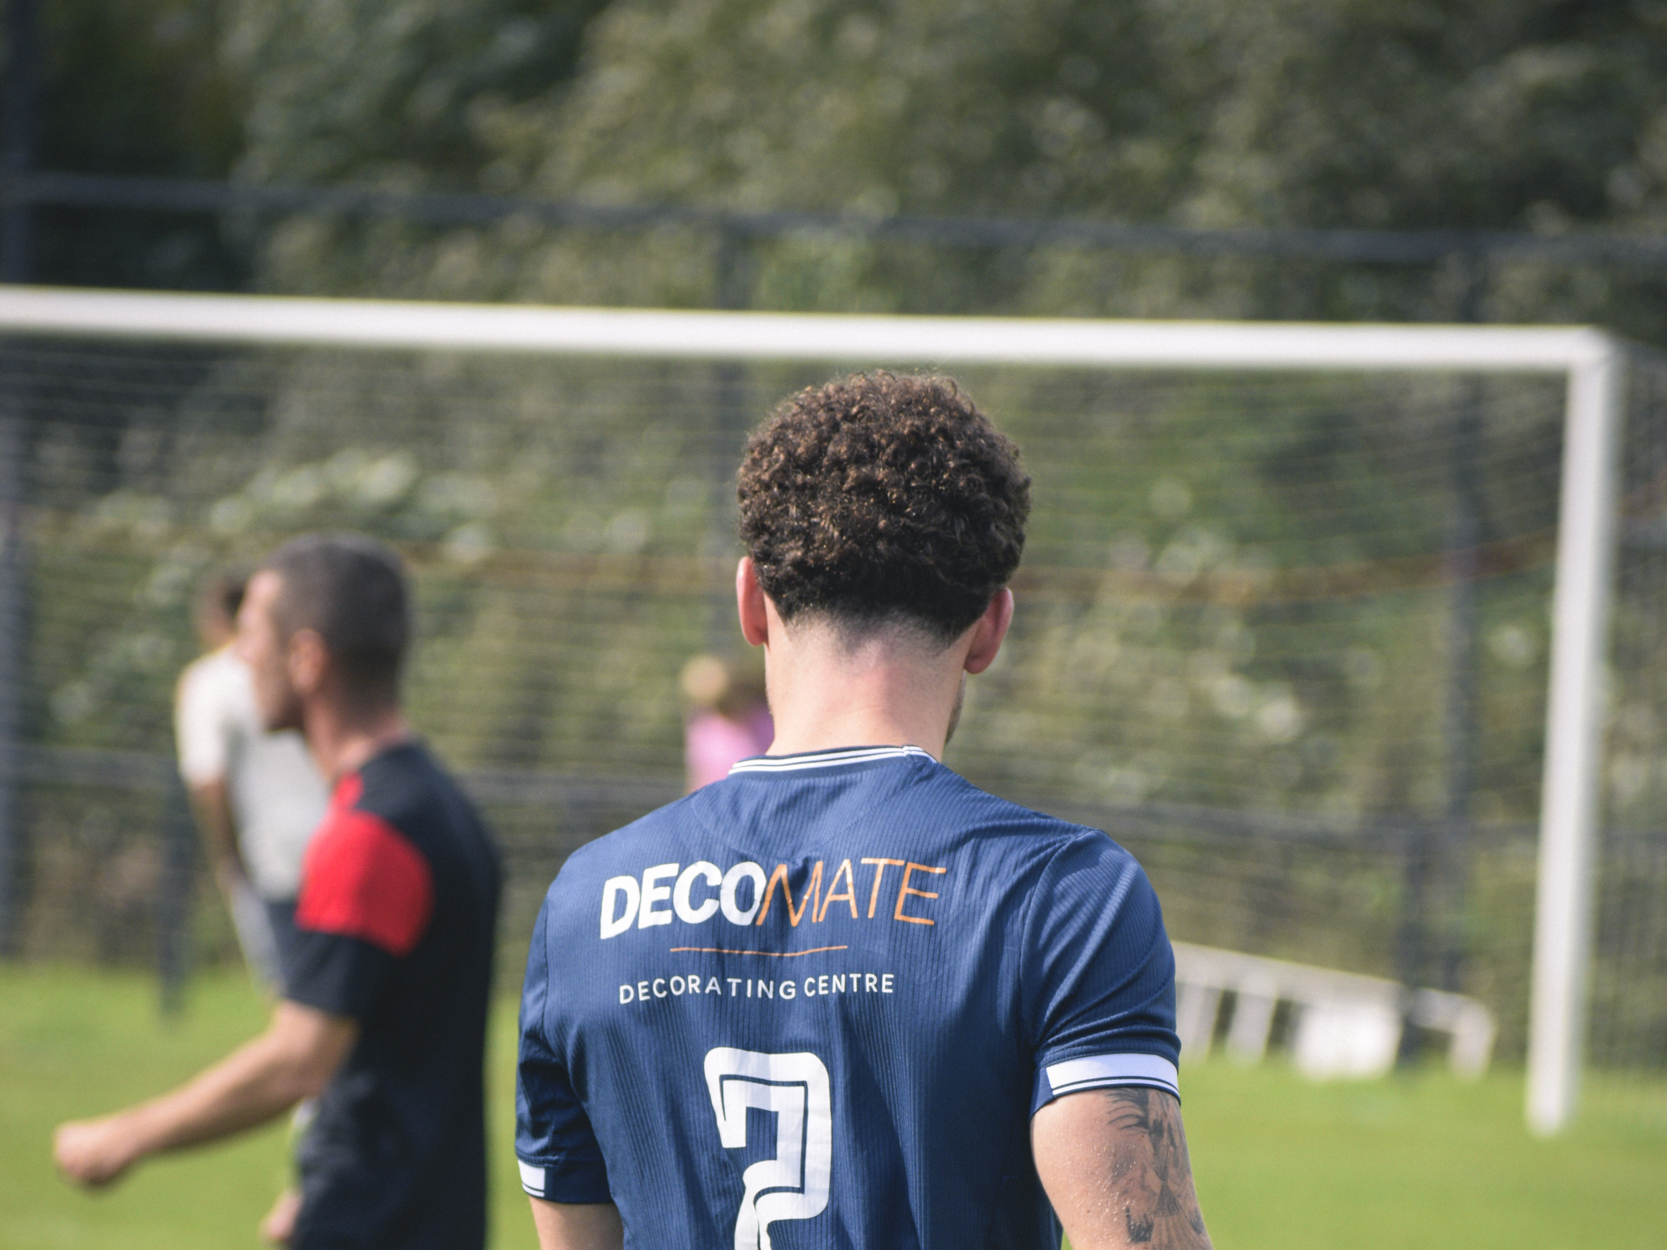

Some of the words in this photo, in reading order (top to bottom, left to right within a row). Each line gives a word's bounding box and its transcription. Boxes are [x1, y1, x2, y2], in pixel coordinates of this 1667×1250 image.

[600, 858, 947, 939] DECOMATE
[619, 974, 797, 1005] DECORATING
[803, 973, 895, 997] CENTRE
